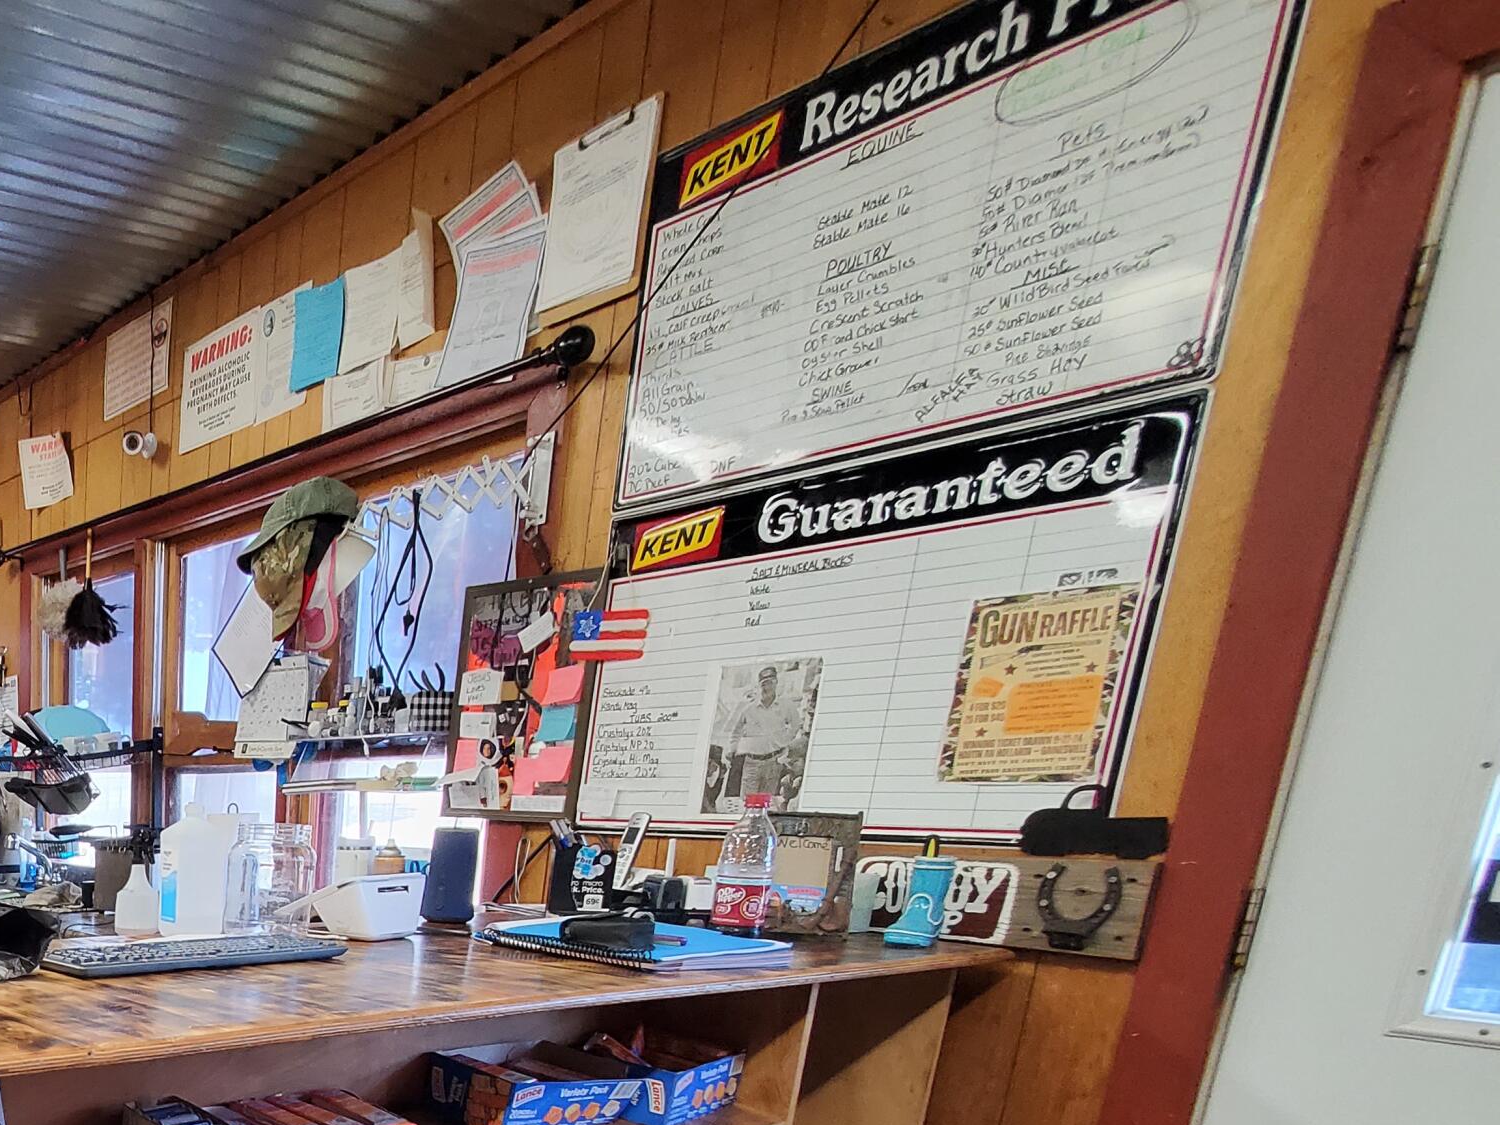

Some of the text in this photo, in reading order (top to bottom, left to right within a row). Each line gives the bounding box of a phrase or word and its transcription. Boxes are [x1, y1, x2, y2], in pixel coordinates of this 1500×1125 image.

[800, 0, 1029, 152] Research
[687, 123, 778, 198] KENT
[847, 120, 917, 166] EQUINE
[897, 185, 914, 201] 12
[813, 226, 852, 250] Stable
[857, 211, 889, 234] Mate
[826, 239, 892, 279] POULTRY
[672, 293, 714, 318] CALVES
[874, 290, 924, 315] Scratch
[190, 323, 253, 373] WARNING:
[654, 338, 715, 371] CATTLE
[852, 336, 883, 356] Shell
[189, 351, 251, 389] DRINKING ALCOHOLIC
[191, 363, 246, 399] BEVERAGES DURING
[186, 371, 251, 410] PREGNANCY MAY CAUSE
[196, 389, 237, 416] BIRTH DEFECTS
[811, 379, 853, 404] SWINE
[756, 417, 1148, 545] Guaranteed
[638, 515, 718, 564] KENT
[979, 604, 1116, 649] GUN RAFFLE
[776, 838, 831, 851] Welcome
[514, 1085, 544, 1103] Lance
[559, 1084, 611, 1098] Variety Pack
[651, 1079, 662, 1114] Lance
